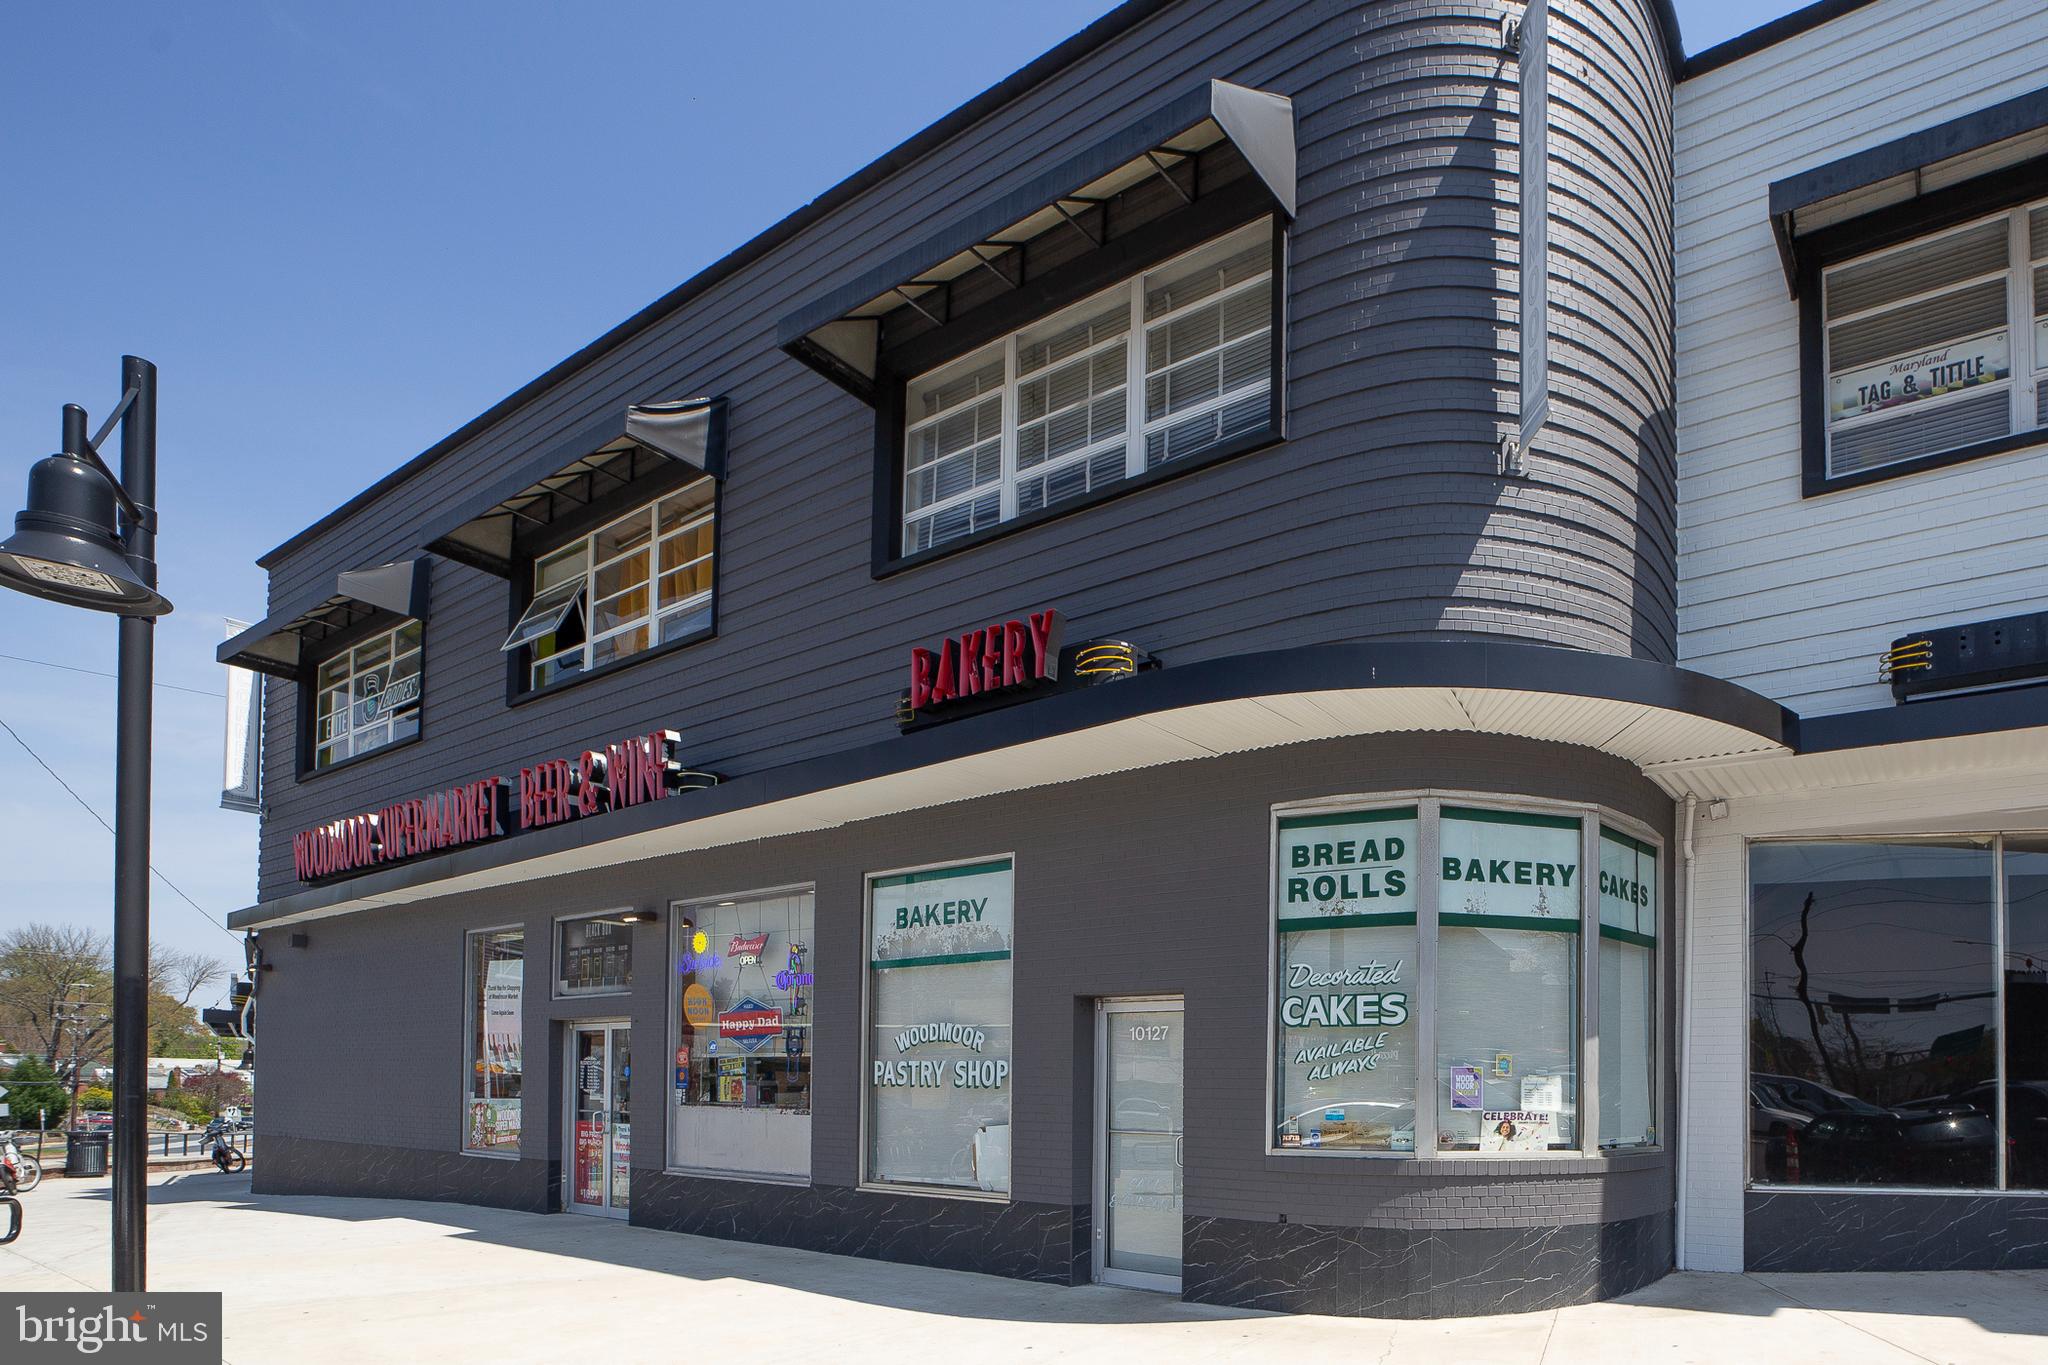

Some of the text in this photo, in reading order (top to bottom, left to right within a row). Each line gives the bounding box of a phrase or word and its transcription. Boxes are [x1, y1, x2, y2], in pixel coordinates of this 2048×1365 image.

[1890, 349, 1951, 375] Maryland
[1858, 356, 1985, 406] TAG & TITTLE
[911, 608, 1059, 709] BAKERY
[293, 729, 674, 881] WOODMOOR SUPERMARKET BEER & WINE
[1291, 837, 1406, 868] BREAD
[1288, 870, 1406, 903] ROLLS
[1442, 857, 1575, 888] BAKERY
[1599, 870, 1649, 907] CAKES
[895, 897, 988, 930] BAKERY
[740, 955, 757, 965] OPEN
[1289, 960, 1403, 989] Decorated
[722, 1016, 779, 1031] Happy Dad
[1281, 992, 1408, 1027] CAKES
[894, 1022, 985, 1053] WOODMOOR
[1129, 1026, 1169, 1041] 10127
[1294, 1032, 1389, 1065] AVAILABLE
[874, 1060, 1008, 1089] PASTRY SHOP
[1307, 1054, 1380, 1081] ALWAYS
[1483, 1112, 1549, 1121] CELEBRATE!
